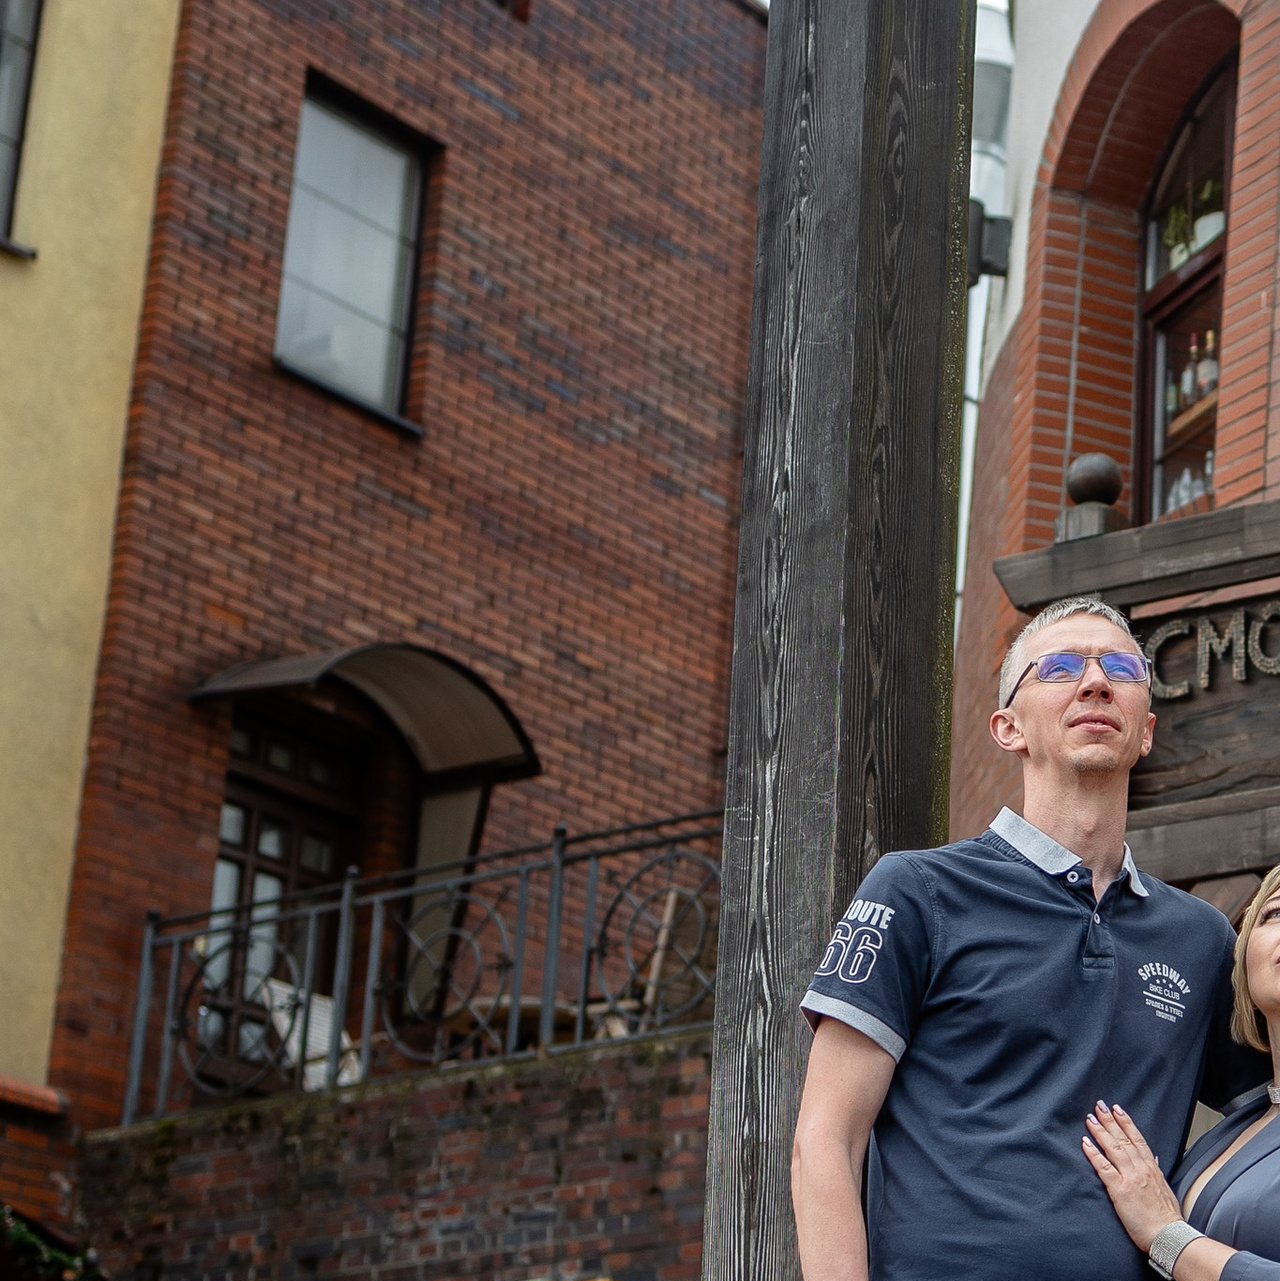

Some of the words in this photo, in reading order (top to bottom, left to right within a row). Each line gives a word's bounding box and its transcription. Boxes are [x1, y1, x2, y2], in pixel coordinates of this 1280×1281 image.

[814, 922, 883, 984] 66
[1137, 962, 1191, 995] SPEEDWAY
[1149, 983, 1163, 995] BIKE
[1163, 988, 1180, 1001] CLUB
